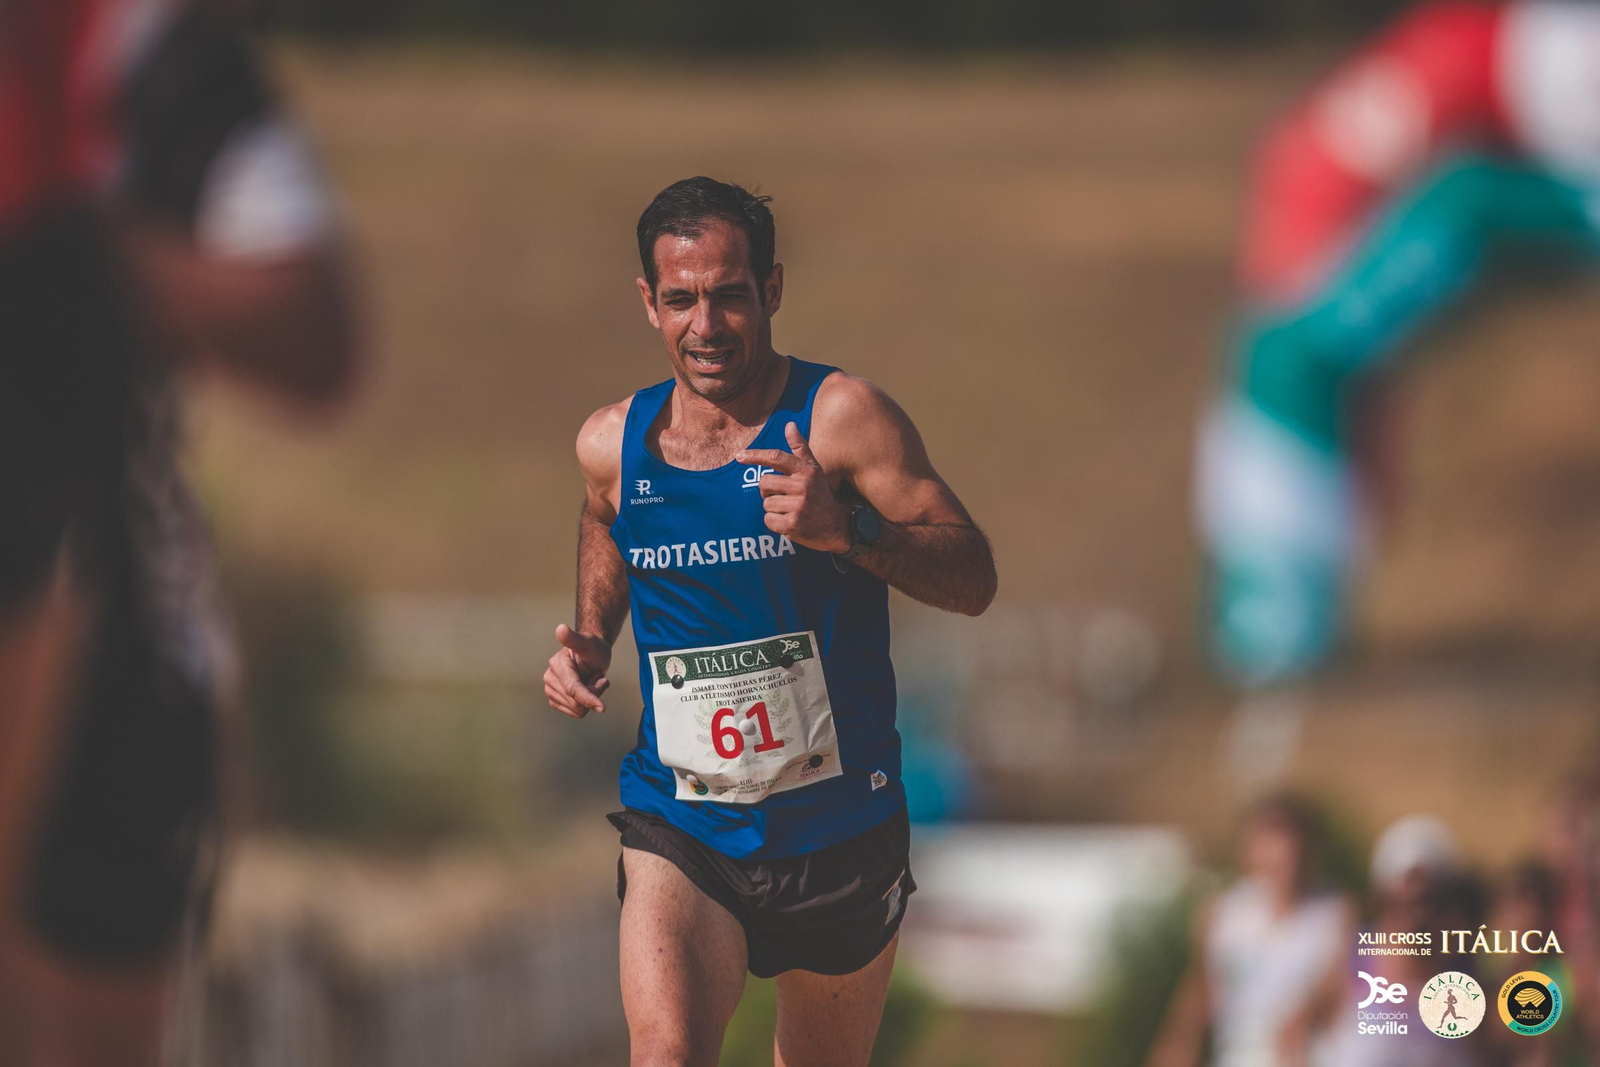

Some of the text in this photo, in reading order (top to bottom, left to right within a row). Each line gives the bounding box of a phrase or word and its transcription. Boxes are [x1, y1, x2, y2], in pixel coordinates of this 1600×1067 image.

[629, 534, 796, 570] TROTASIERRA
[694, 649, 771, 674] ITÁLICA
[680, 676, 798, 702] CLUB ATLETISMO HORNACHUELOS
[691, 672, 783, 693] ISMAEL CONTRERAS PÉREZ
[715, 694, 763, 707] TROTASIERRA
[711, 701, 785, 760] 61
